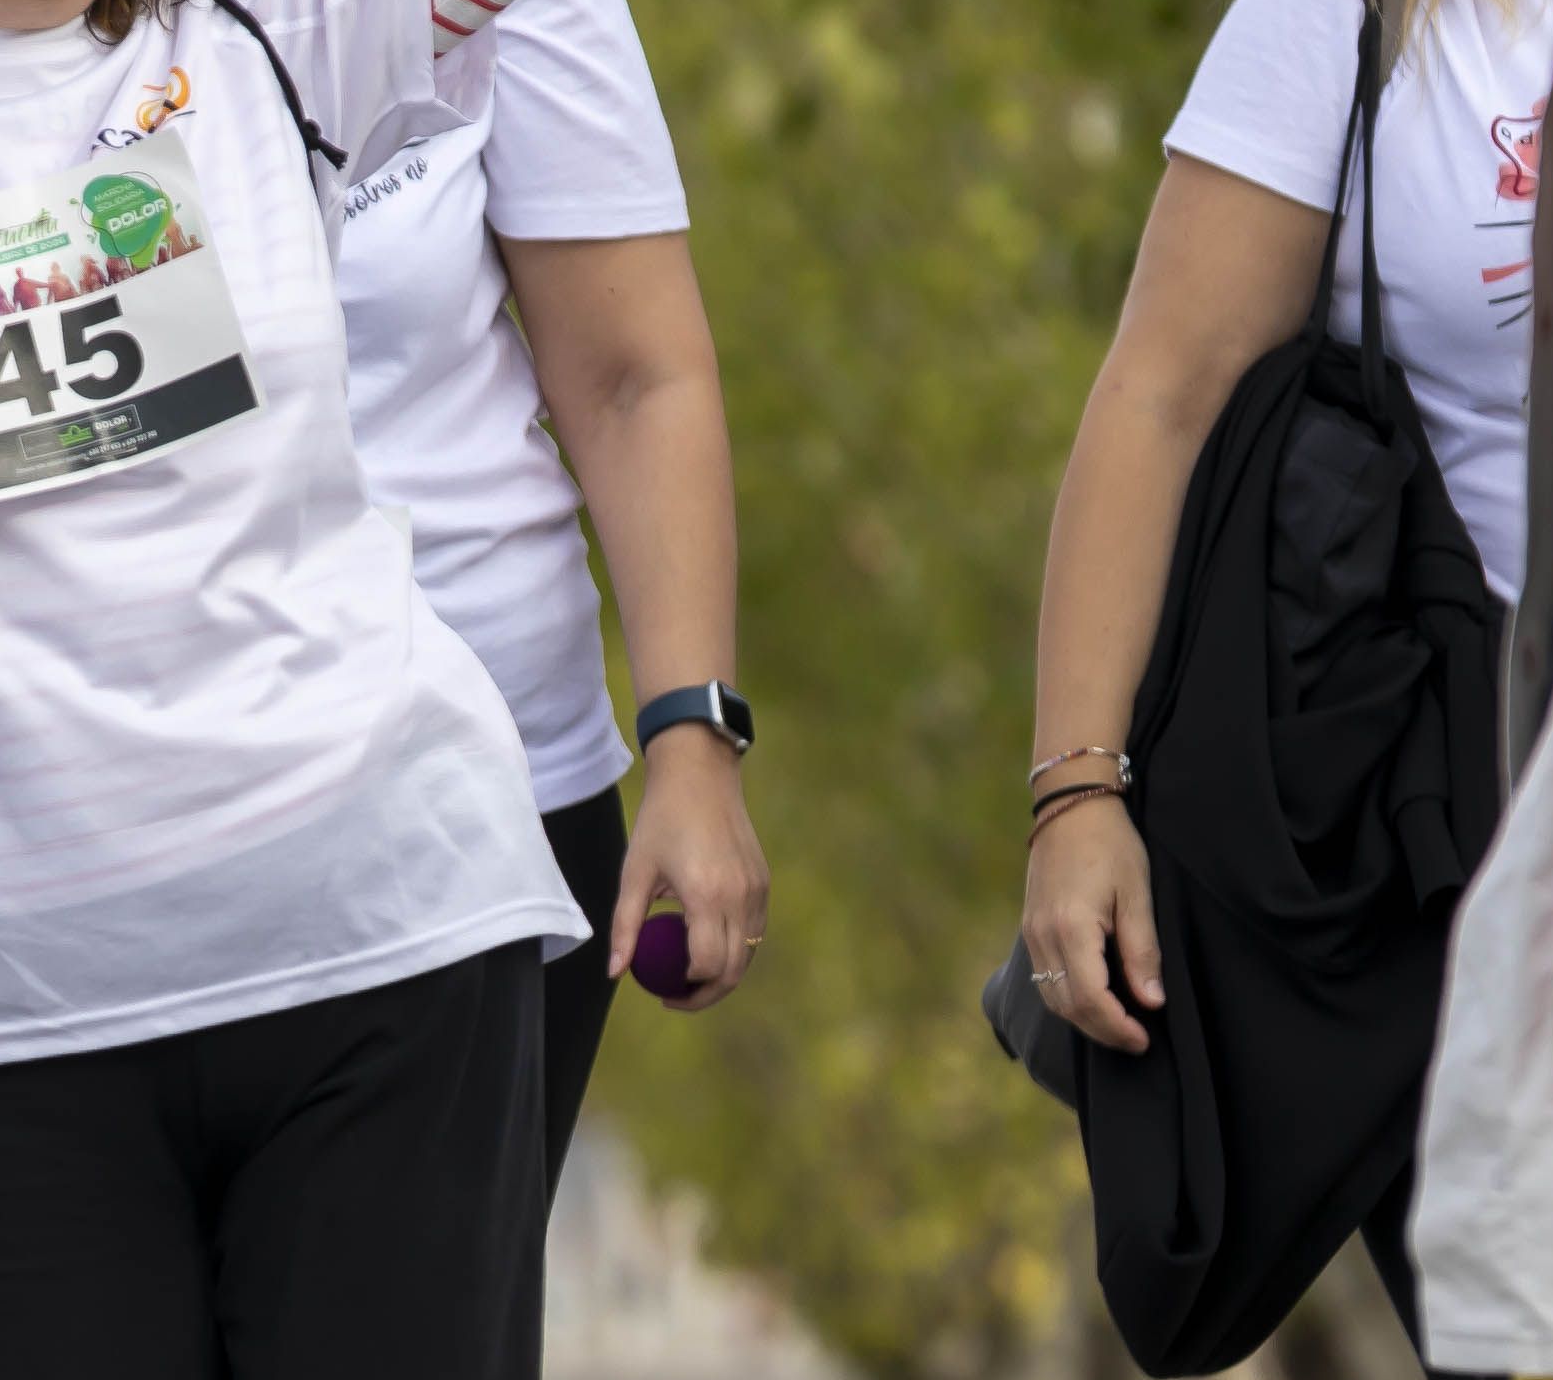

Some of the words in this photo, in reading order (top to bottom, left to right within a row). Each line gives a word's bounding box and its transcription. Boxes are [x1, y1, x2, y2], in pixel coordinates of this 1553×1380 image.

[343, 173, 402, 223] sotros
[405, 156, 429, 180] no
[107, 198, 168, 232] DOLOR
